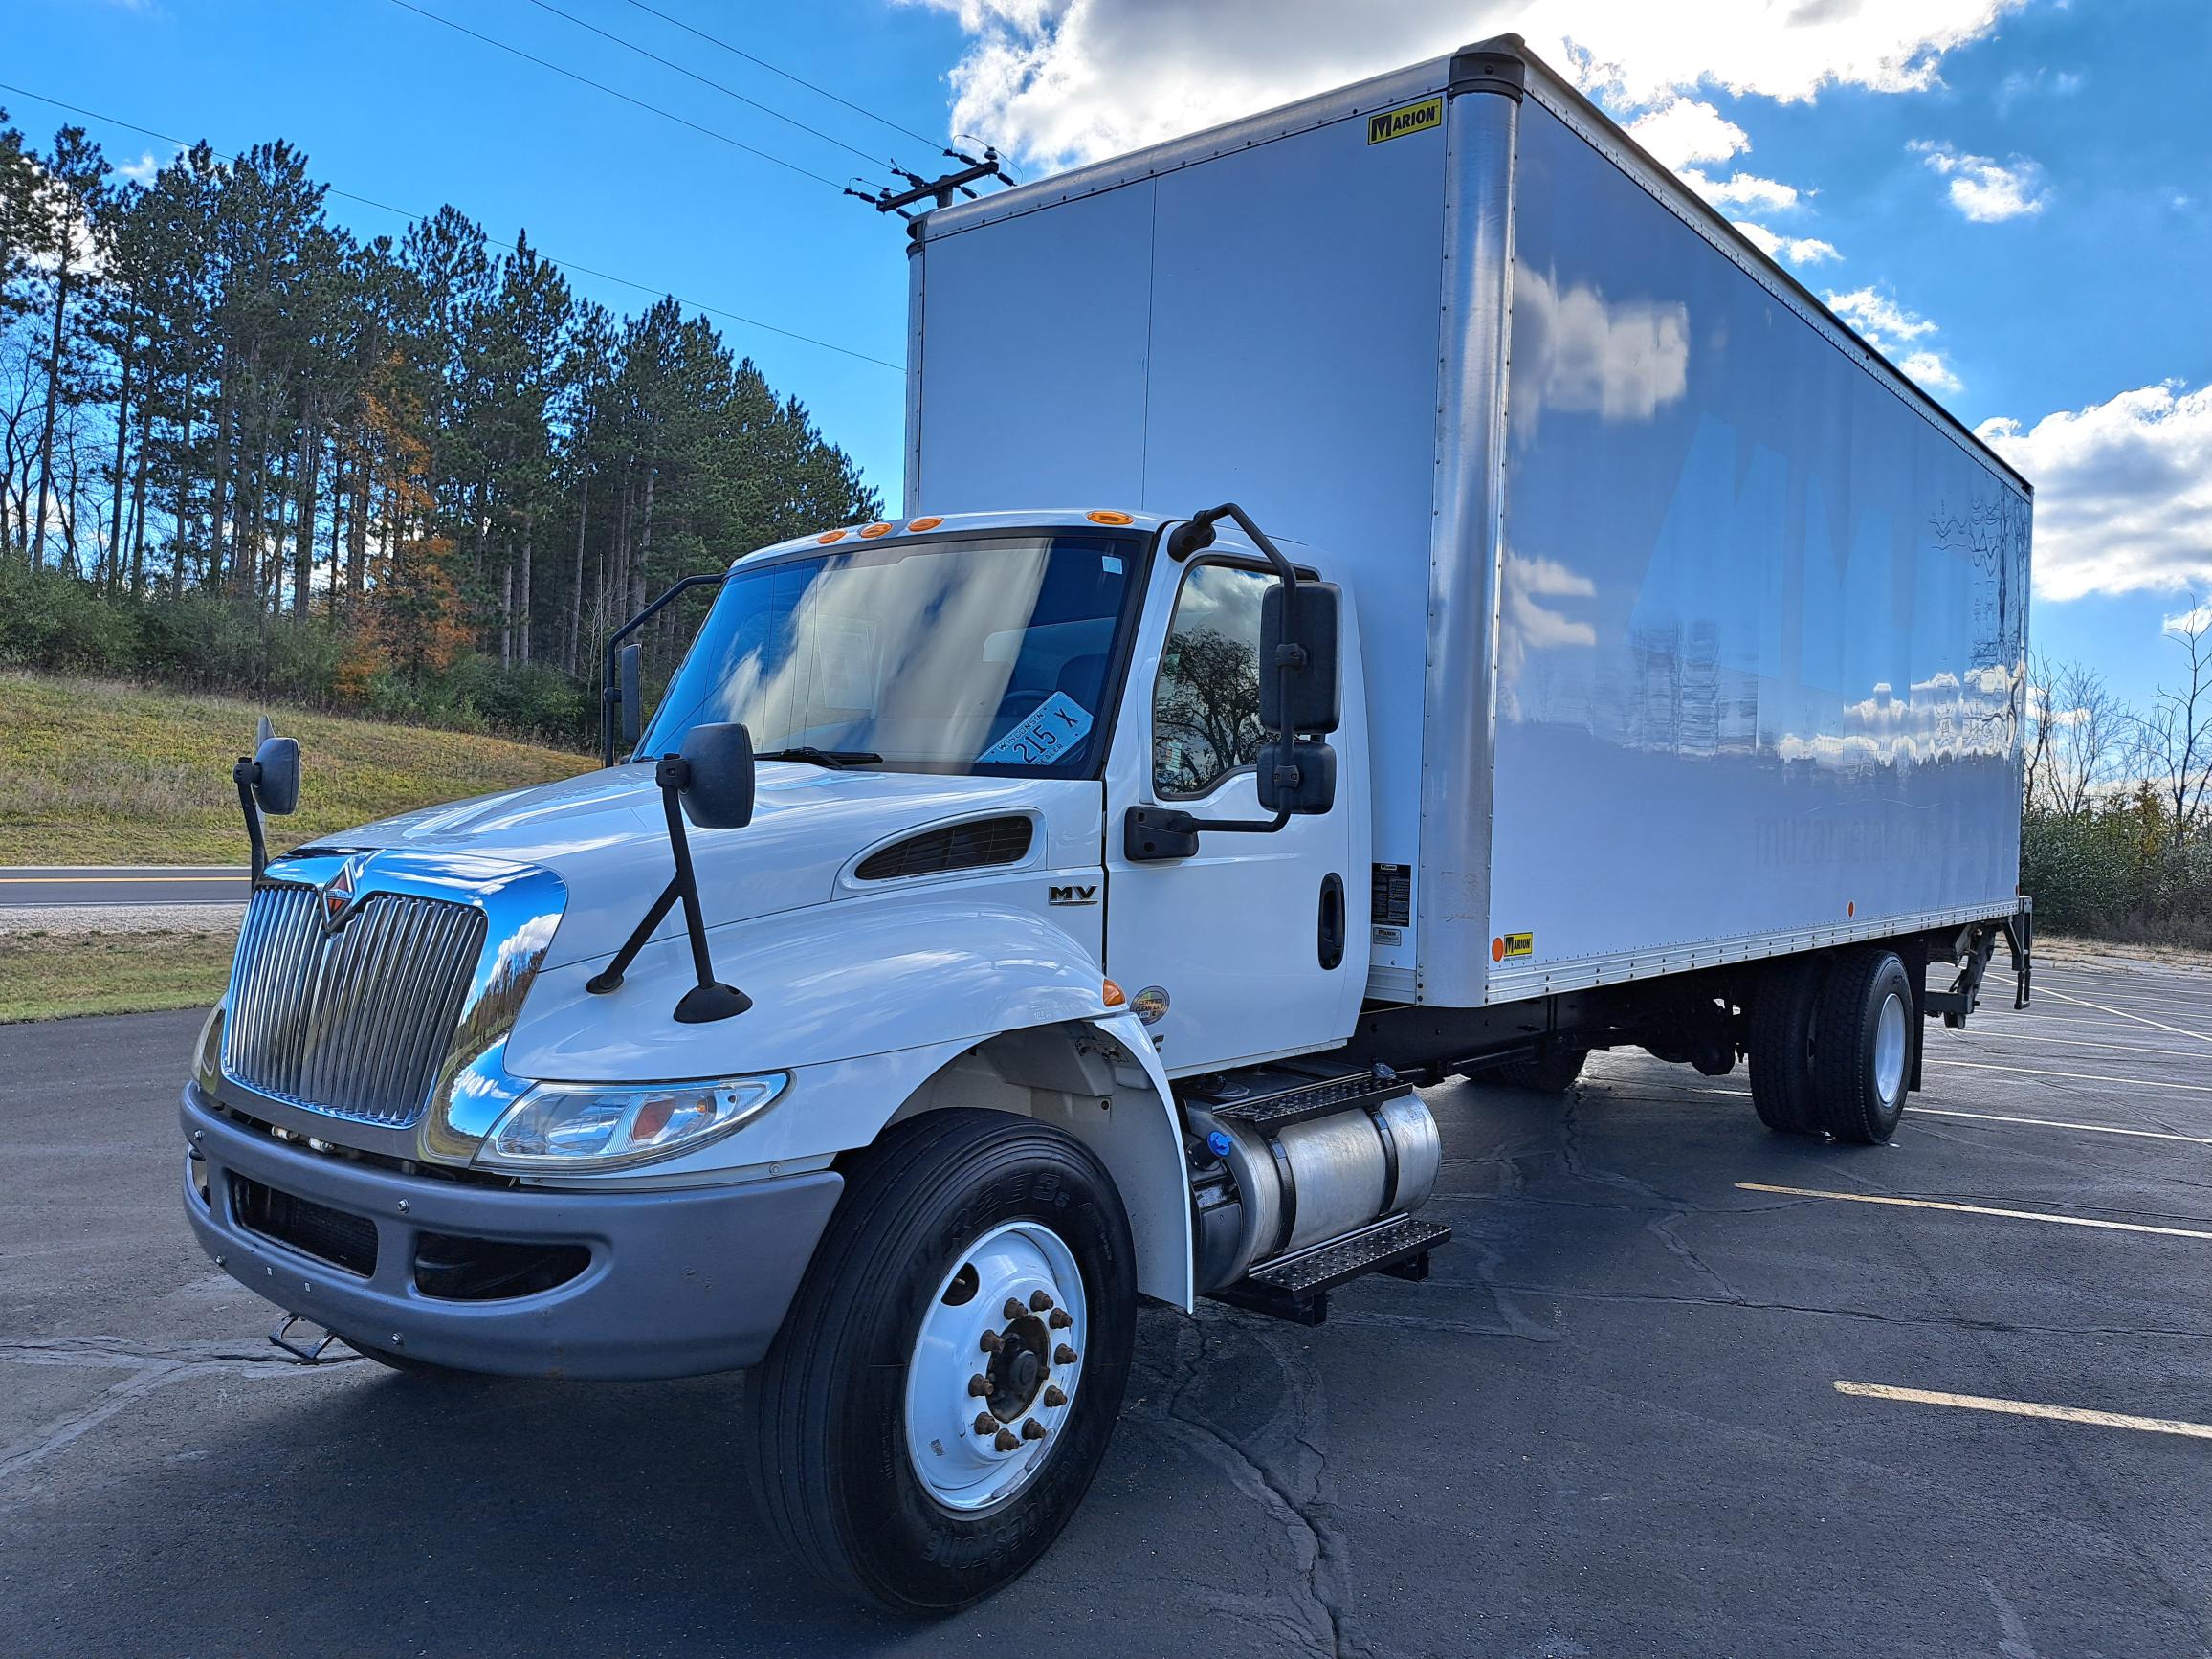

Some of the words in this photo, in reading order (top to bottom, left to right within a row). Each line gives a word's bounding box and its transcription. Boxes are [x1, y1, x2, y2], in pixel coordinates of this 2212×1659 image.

[1370, 106, 1435, 142] MARION
[998, 712, 1046, 753] WISCONSIN
[1012, 724, 1057, 764] 215
[1053, 707, 1079, 728] X
[1049, 884, 1099, 901] MV
[1505, 937, 1531, 954] MARION
